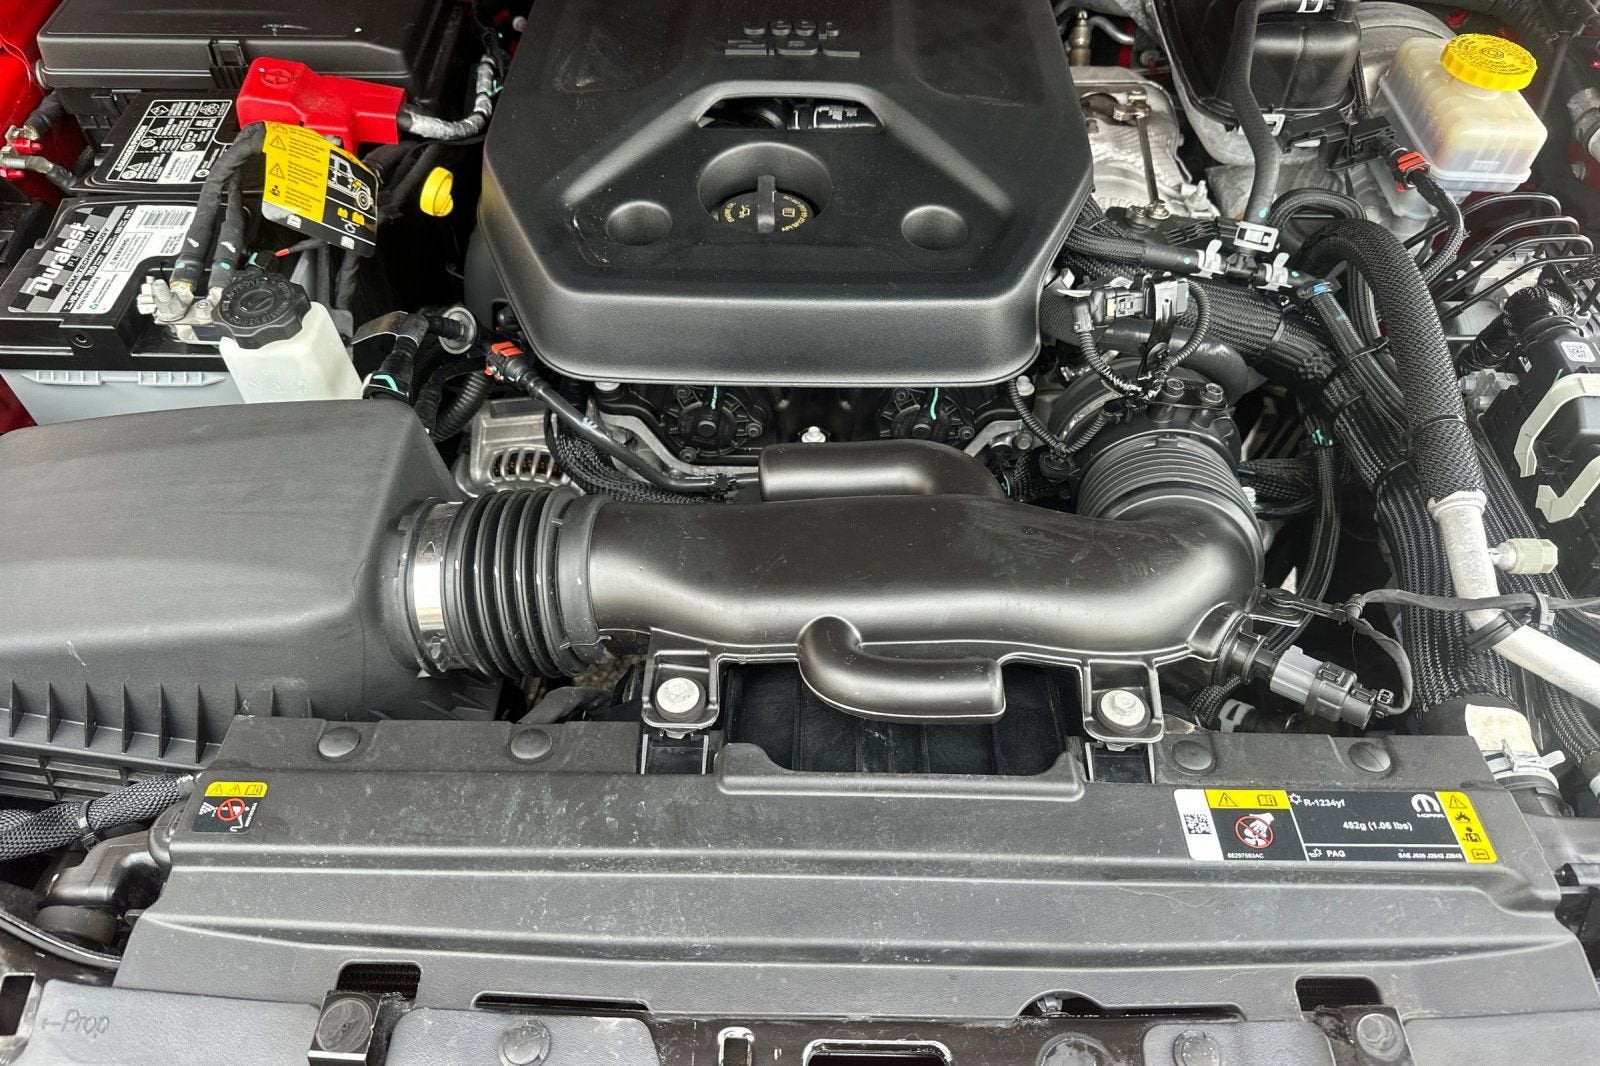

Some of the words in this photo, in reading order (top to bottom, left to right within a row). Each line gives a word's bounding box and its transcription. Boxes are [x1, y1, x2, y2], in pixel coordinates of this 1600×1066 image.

[29, 223, 91, 292] Duralast
[64, 275, 79, 292] AGM
[76, 227, 109, 272] TECHNOLOGY
[1303, 798, 1345, 808] R-1234yf
[1342, 821, 1367, 831] 482g
[1369, 821, 1391, 831] (1.06
[1392, 821, 1413, 831] lbs)
[1326, 850, 1346, 858] PAG
[61, 1008, 110, 1042] Prop
